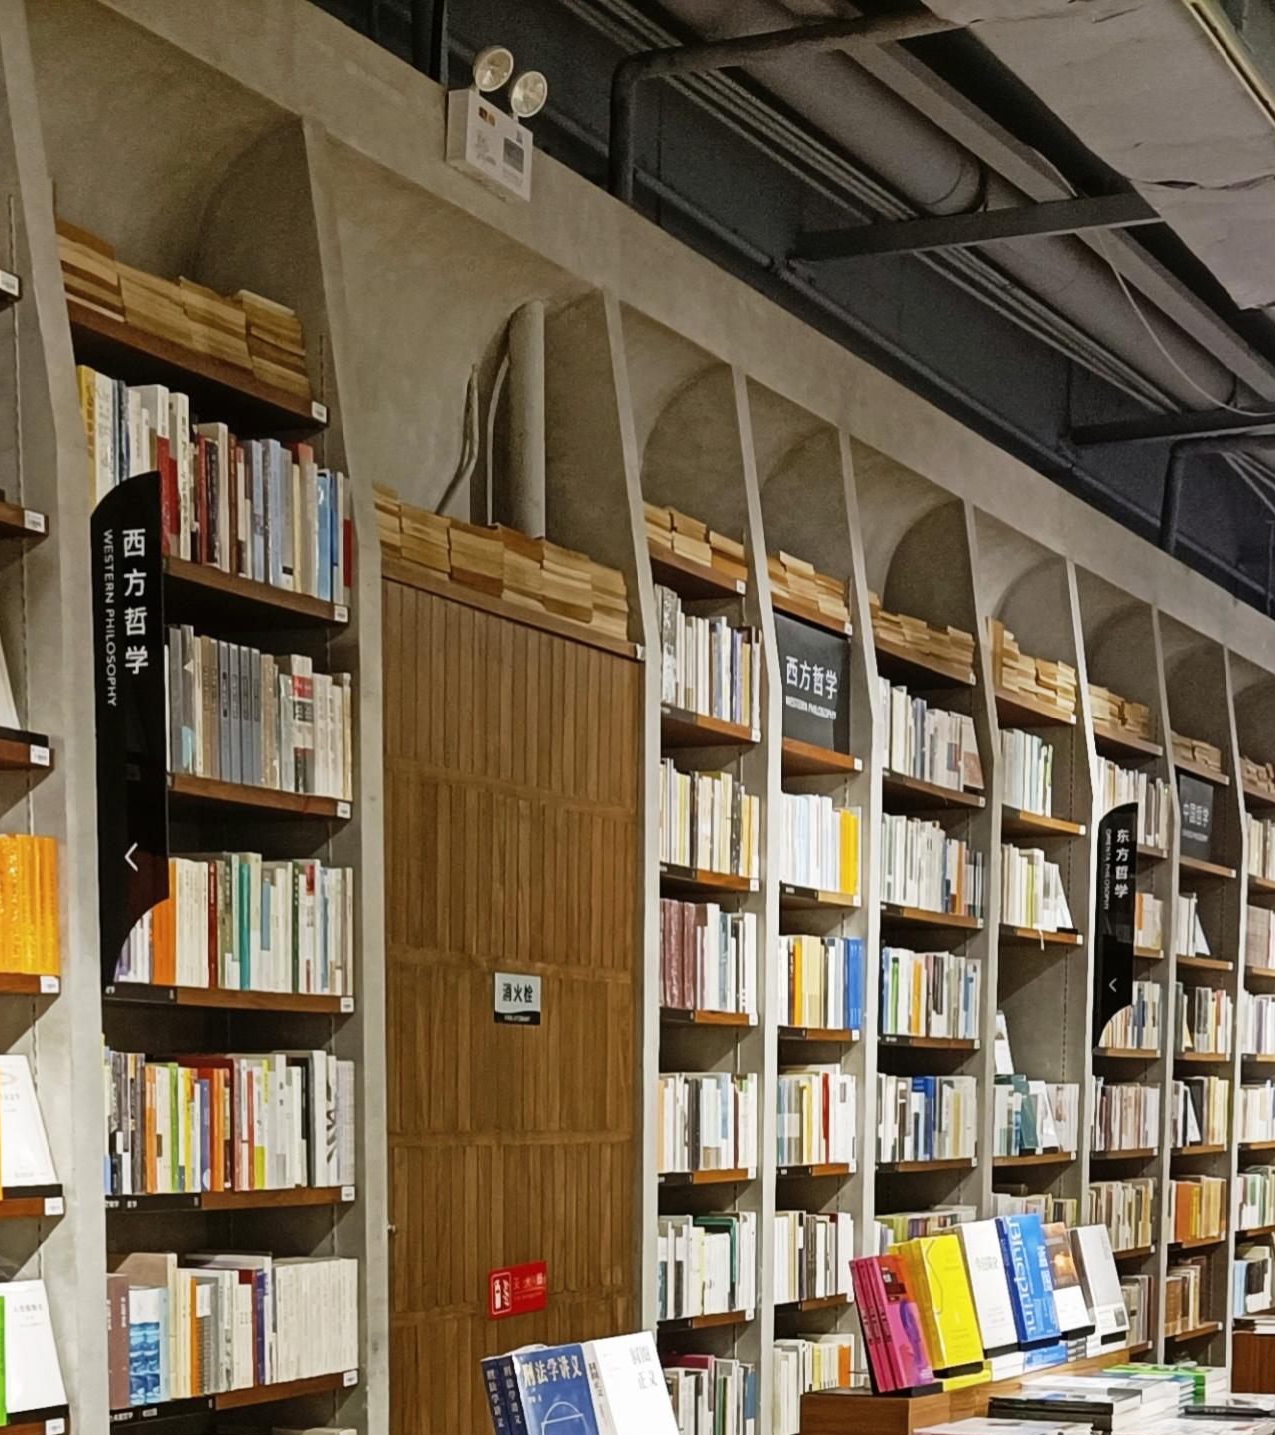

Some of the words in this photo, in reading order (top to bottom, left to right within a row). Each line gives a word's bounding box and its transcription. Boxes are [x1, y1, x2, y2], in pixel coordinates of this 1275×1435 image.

[103, 529, 115, 603] WESTERN
[122, 528, 149, 674] 西方哲学
[105, 608, 117, 706] PHILOSOPHY
[785, 656, 838, 699] 西方哲学
[1114, 828, 1130, 898] 东方哲学
[502, 983, 533, 1003] 消火栓
[522, 1354, 582, 1388] 刑法学讲义
